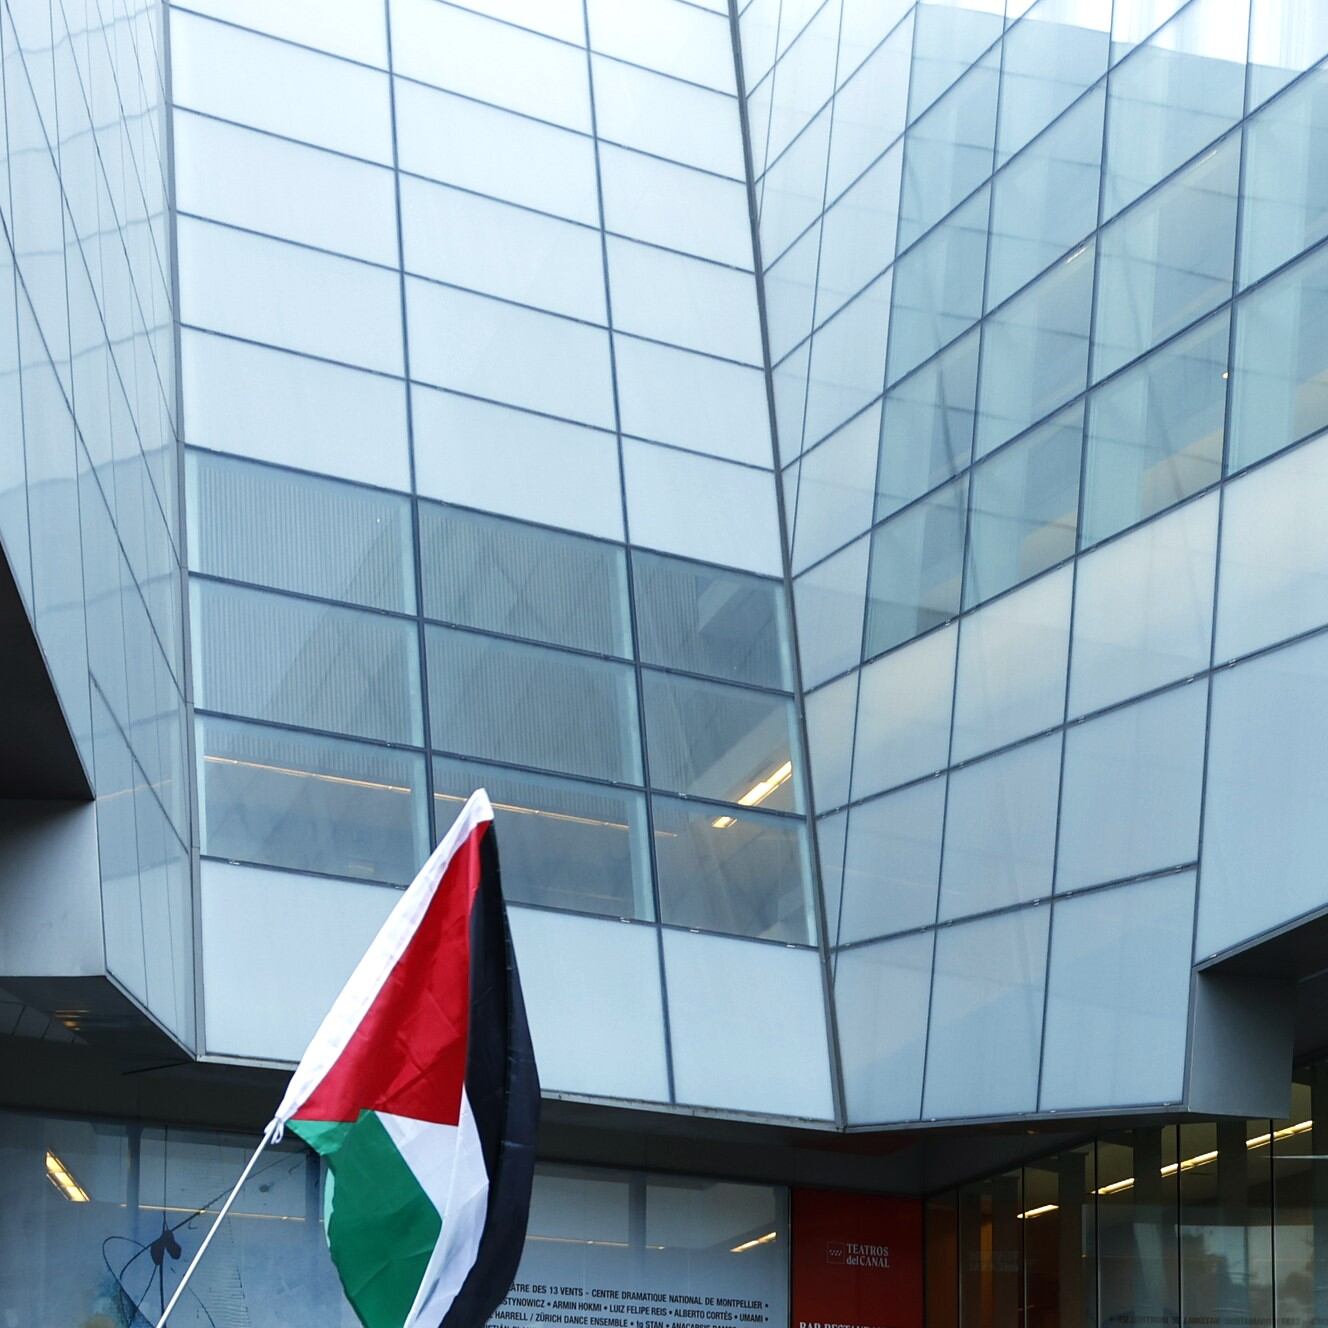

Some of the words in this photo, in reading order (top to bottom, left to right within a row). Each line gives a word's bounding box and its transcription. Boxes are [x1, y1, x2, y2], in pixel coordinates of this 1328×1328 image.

[847, 1243, 889, 1257] TEATROS
[533, 1284, 546, 1294] DES
[550, 1286, 559, 1295] 13
[560, 1287, 583, 1296] VENTS
[592, 1290, 619, 1299] CENTRE
[622, 1292, 666, 1302] DRAMATIQUE
[669, 1295, 702, 1305] NATIONAL
[705, 1297, 714, 1305] DE
[716, 1299, 762, 1309] MONTPELLIER
[495, 1312, 528, 1321] HARRELL
[535, 1313, 562, 1323] ZÜRICH
[564, 1317, 588, 1325] DANCE
[590, 1318, 628, 1327] ENSEMBLE
[646, 1321, 663, 1328] STAN
[553, 1300, 577, 1310] ARMIN
[579, 1302, 602, 1311] HOKMI
[610, 1304, 625, 1313] LUIZ
[627, 1305, 650, 1315] FELIPE
[651, 1307, 667, 1316] REIS
[675, 1309, 705, 1319] ALBERTO
[707, 1310, 732, 1320] CORTÉS
[740, 1314, 763, 1322] UMAMI
